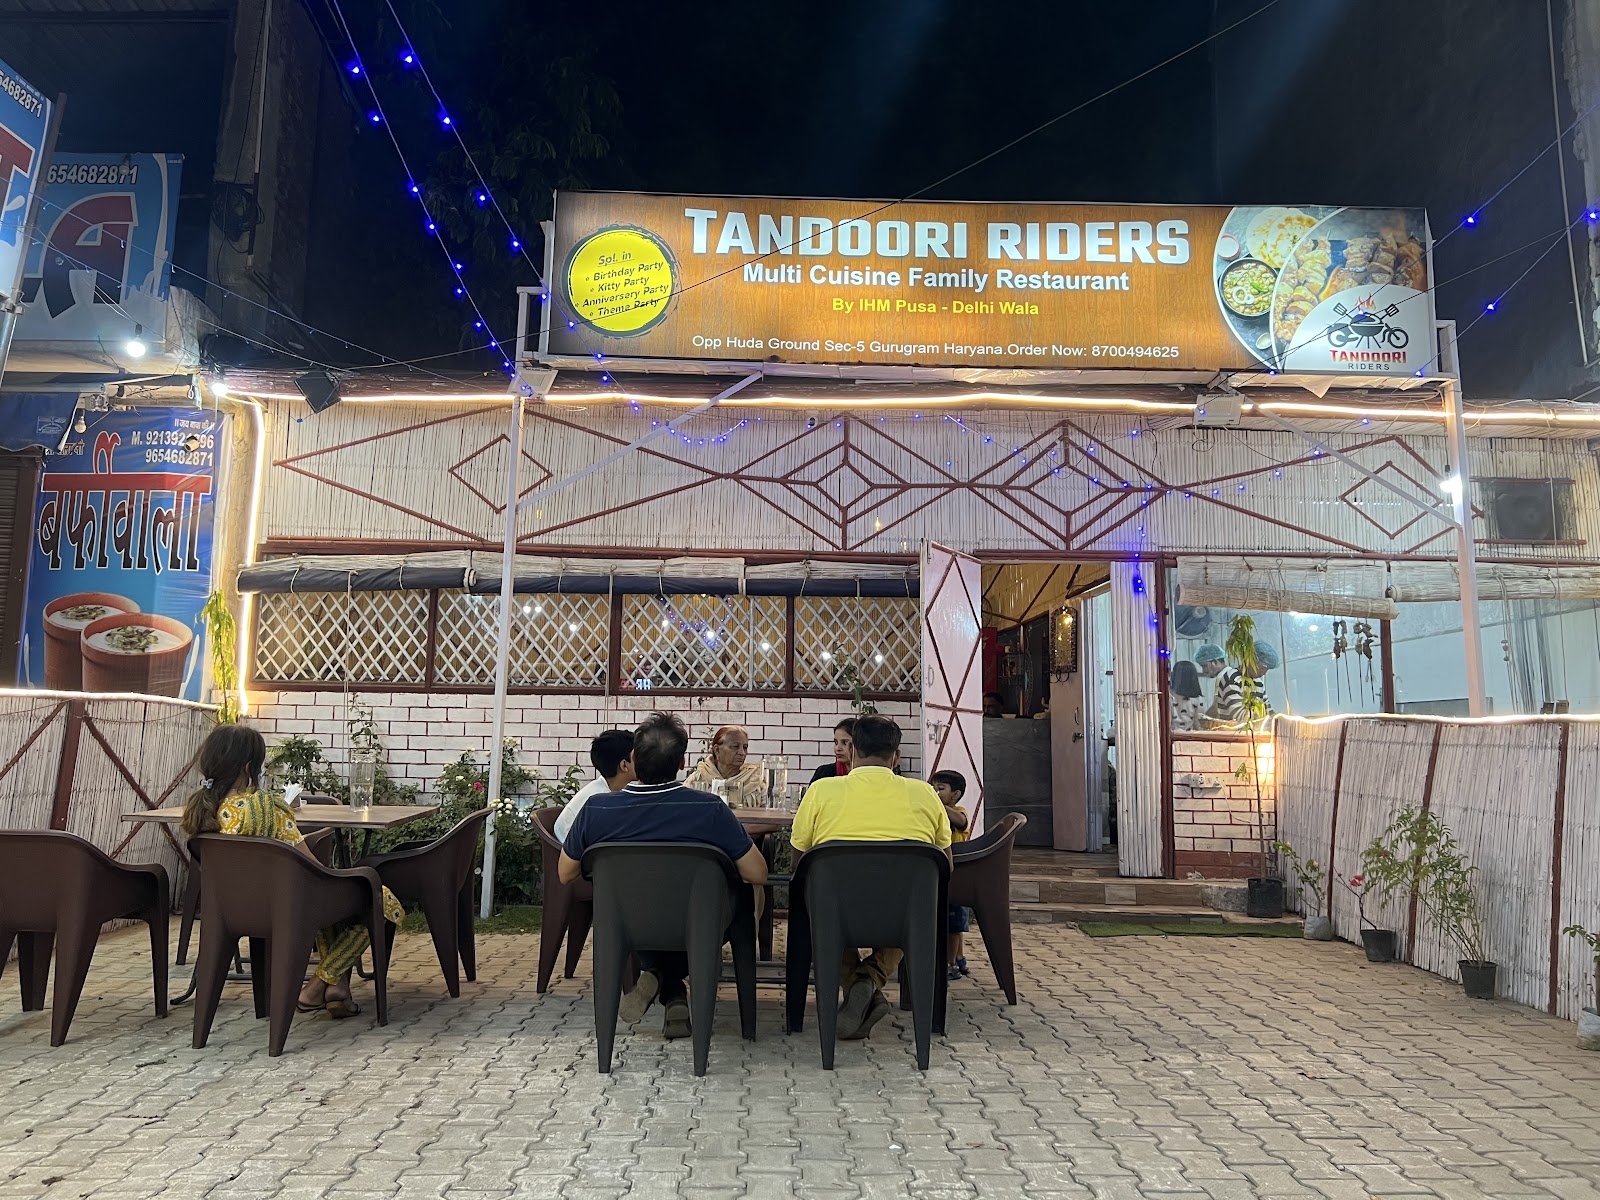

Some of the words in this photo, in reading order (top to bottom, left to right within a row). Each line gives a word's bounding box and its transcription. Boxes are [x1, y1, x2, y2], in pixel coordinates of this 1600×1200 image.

[684, 208, 967, 258] TANDOORI
[987, 219, 1190, 265] RIDERS
[622, 251, 632, 260] in
[593, 267, 635, 282] Birthday
[638, 261, 664, 272] Party
[743, 263, 801, 284] Multi
[809, 264, 900, 286] Cuisine
[909, 267, 989, 293] Family
[996, 269, 1129, 291] Restaurant
[598, 282, 621, 293] Kitty
[624, 276, 649, 287] Party
[643, 284, 669, 295] Party
[598, 304, 630, 316] Theme
[633, 298, 660, 310] Party
[832, 298, 854, 314] By
[859, 299, 890, 312] IHM
[895, 299, 937, 313] Pusa
[952, 301, 994, 314] Delhi
[999, 302, 1039, 315] Wala
[692, 335, 722, 348] Opp
[726, 336, 764, 349] Huda
[768, 337, 820, 351] Ground
[824, 340, 865, 352] Sec-5
[869, 341, 940, 355] Gurugram
[1052, 345, 1087, 357] Now:
[1091, 345, 1179, 358] 8700494625
[1329, 350, 1407, 363] TANDOORI
[131, 431, 143, 446] M.
[146, 449, 214, 466] 9654682871
